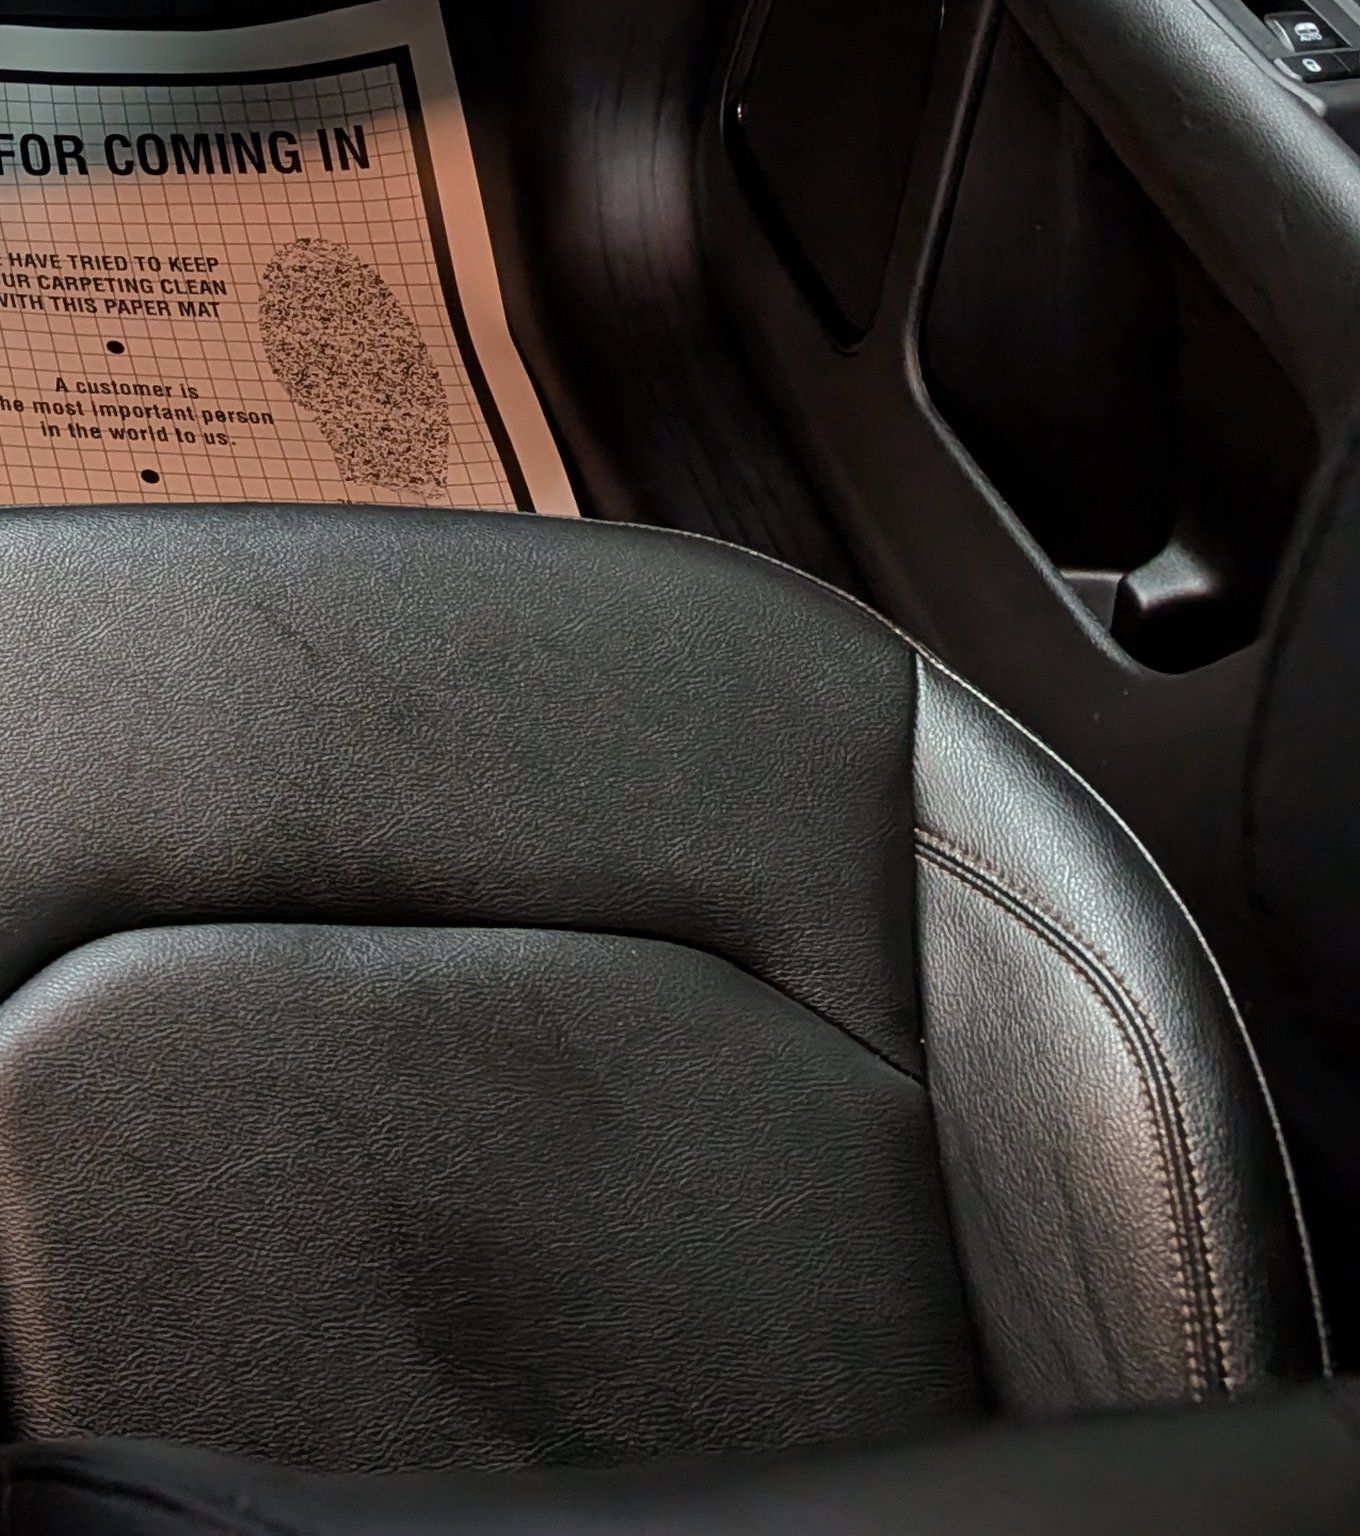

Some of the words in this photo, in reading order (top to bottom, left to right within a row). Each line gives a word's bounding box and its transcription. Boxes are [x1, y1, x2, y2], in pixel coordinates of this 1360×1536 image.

[103, 130, 306, 177] COMING
[316, 124, 372, 173] IN
[7, 252, 63, 270] HAVE
[66, 254, 129, 272] TRIED
[133, 256, 162, 272] TO
[168, 257, 220, 274] KEEP
[36, 275, 154, 294] CARPETING
[160, 278, 228, 296] CLEAN
[48, 296, 98, 314] THIS
[103, 299, 173, 317] PAPER
[178, 301, 221, 318] MAT
[55, 377, 69, 393] A
[76, 380, 173, 398] customer
[181, 383, 200, 400] is
[32, 399, 85, 417] most
[91, 401, 196, 423] important
[201, 408, 275, 425] person
[40, 421, 61, 438] in
[67, 422, 102, 440] the
[108, 425, 169, 443] world
[175, 428, 196, 445] to
[203, 432, 237, 447] us.
